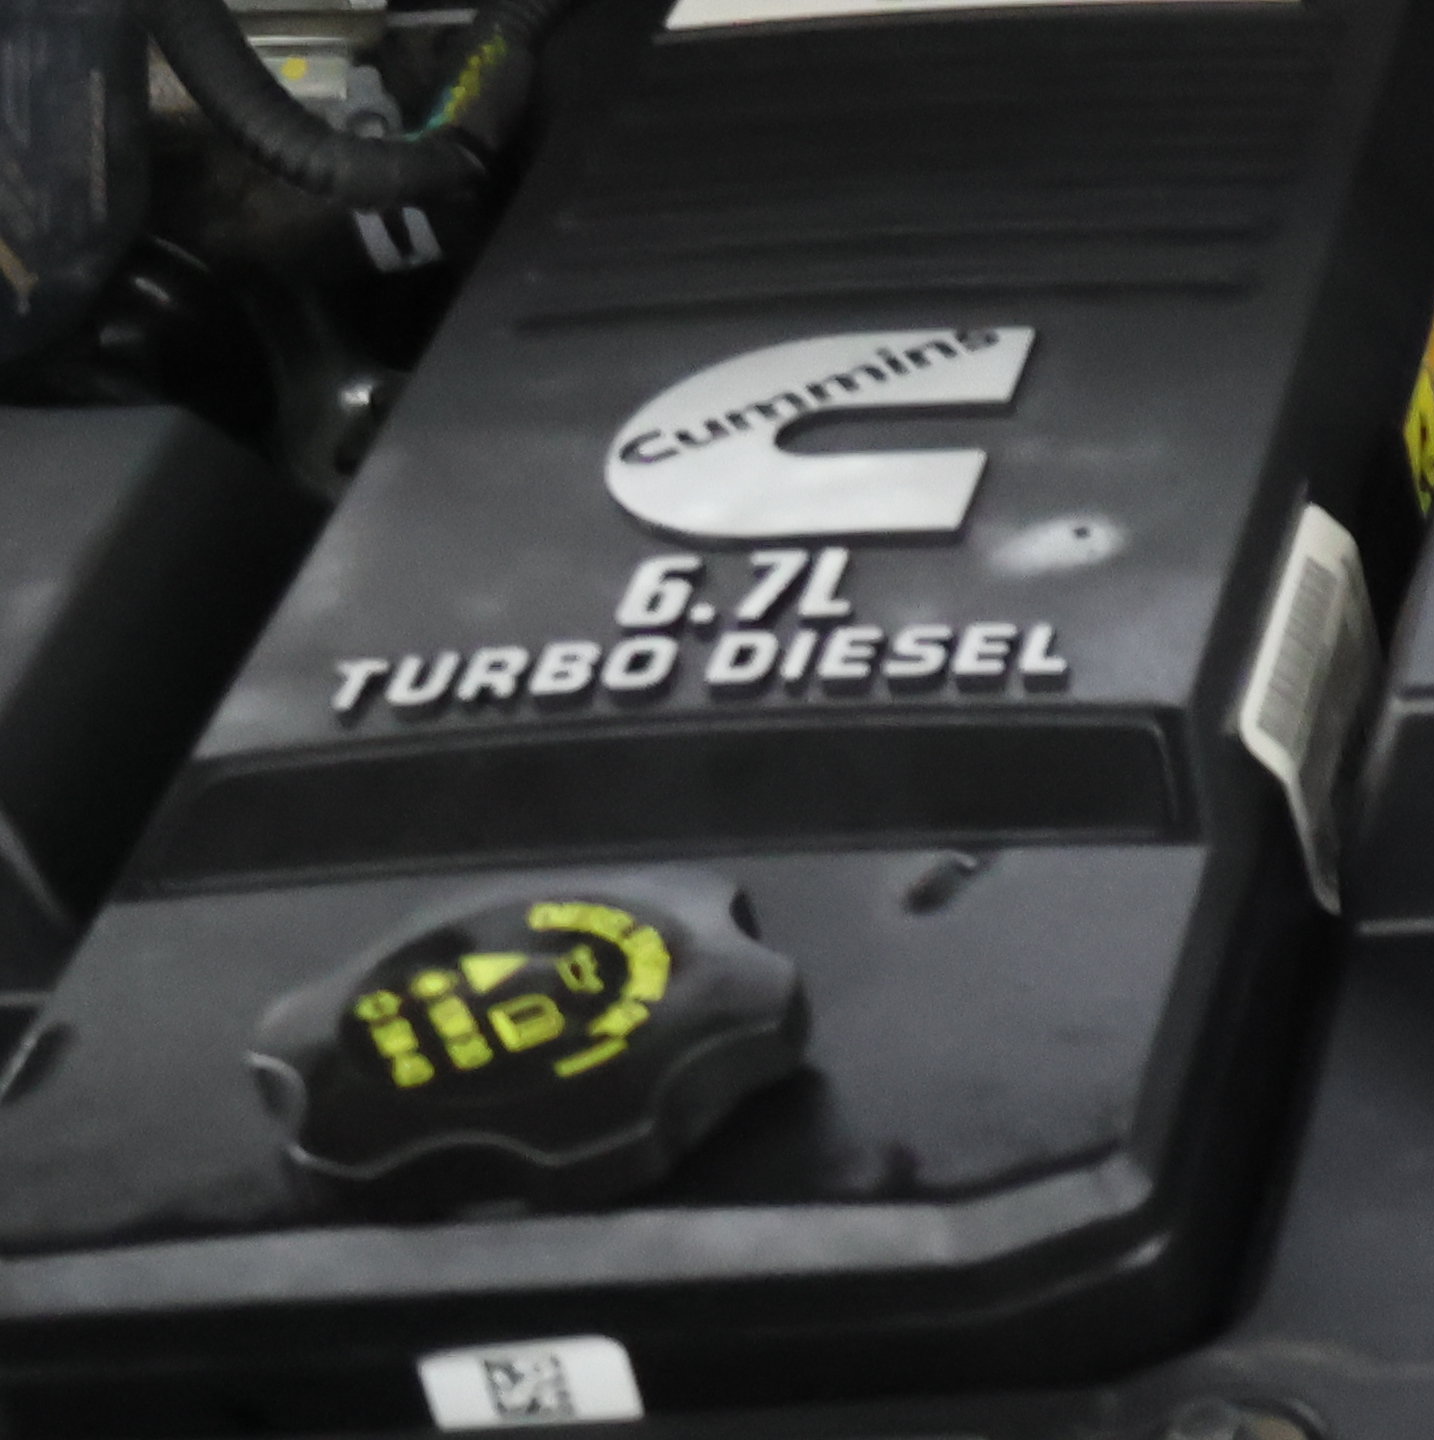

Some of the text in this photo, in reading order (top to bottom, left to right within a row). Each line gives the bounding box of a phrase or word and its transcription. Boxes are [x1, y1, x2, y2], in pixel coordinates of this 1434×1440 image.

[619, 327, 1000, 464] Cummins
[615, 546, 851, 628] 6.7L
[332, 622, 1068, 711] TURBO DIESEL
